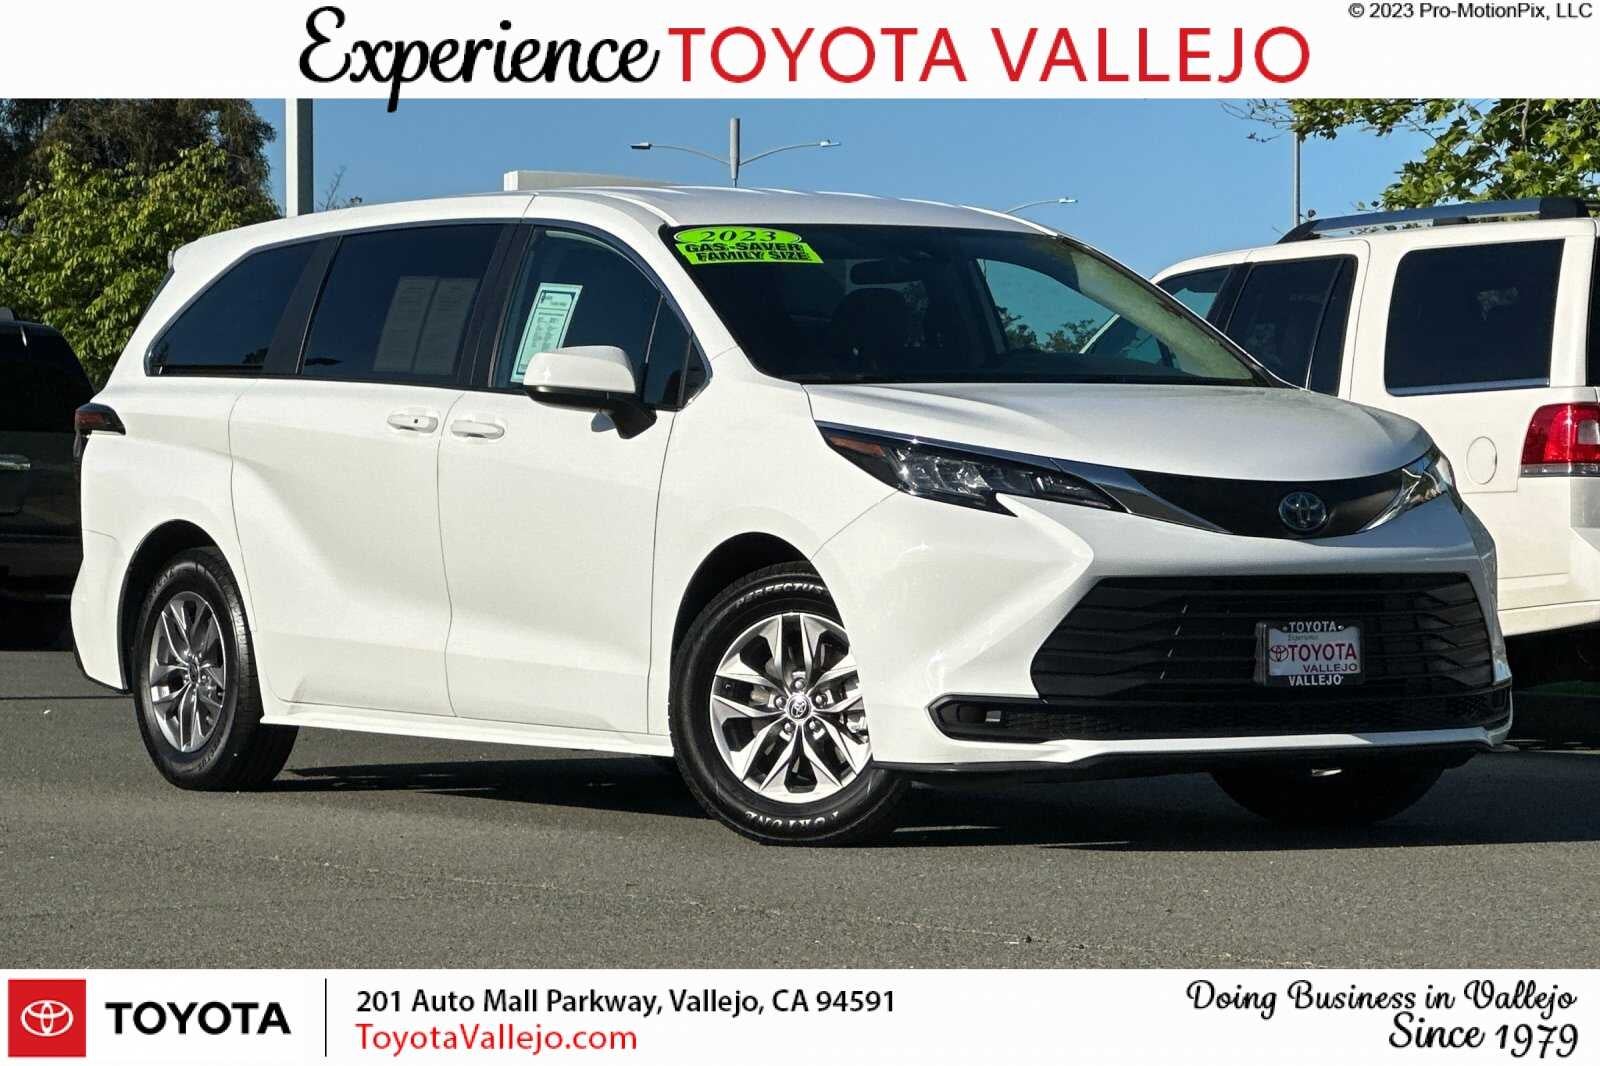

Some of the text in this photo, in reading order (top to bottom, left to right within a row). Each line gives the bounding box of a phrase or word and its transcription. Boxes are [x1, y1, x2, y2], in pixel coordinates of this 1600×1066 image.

[700, 230, 777, 242] 2023
[685, 243, 802, 253] GAS-SAVER
[696, 251, 811, 262] FAMILY SIZE
[1288, 622, 1336, 632] TOYOTA
[1288, 643, 1357, 661] TOYOTA
[1303, 663, 1357, 673] VALLEJO
[1288, 675, 1342, 685] VALLEJO
